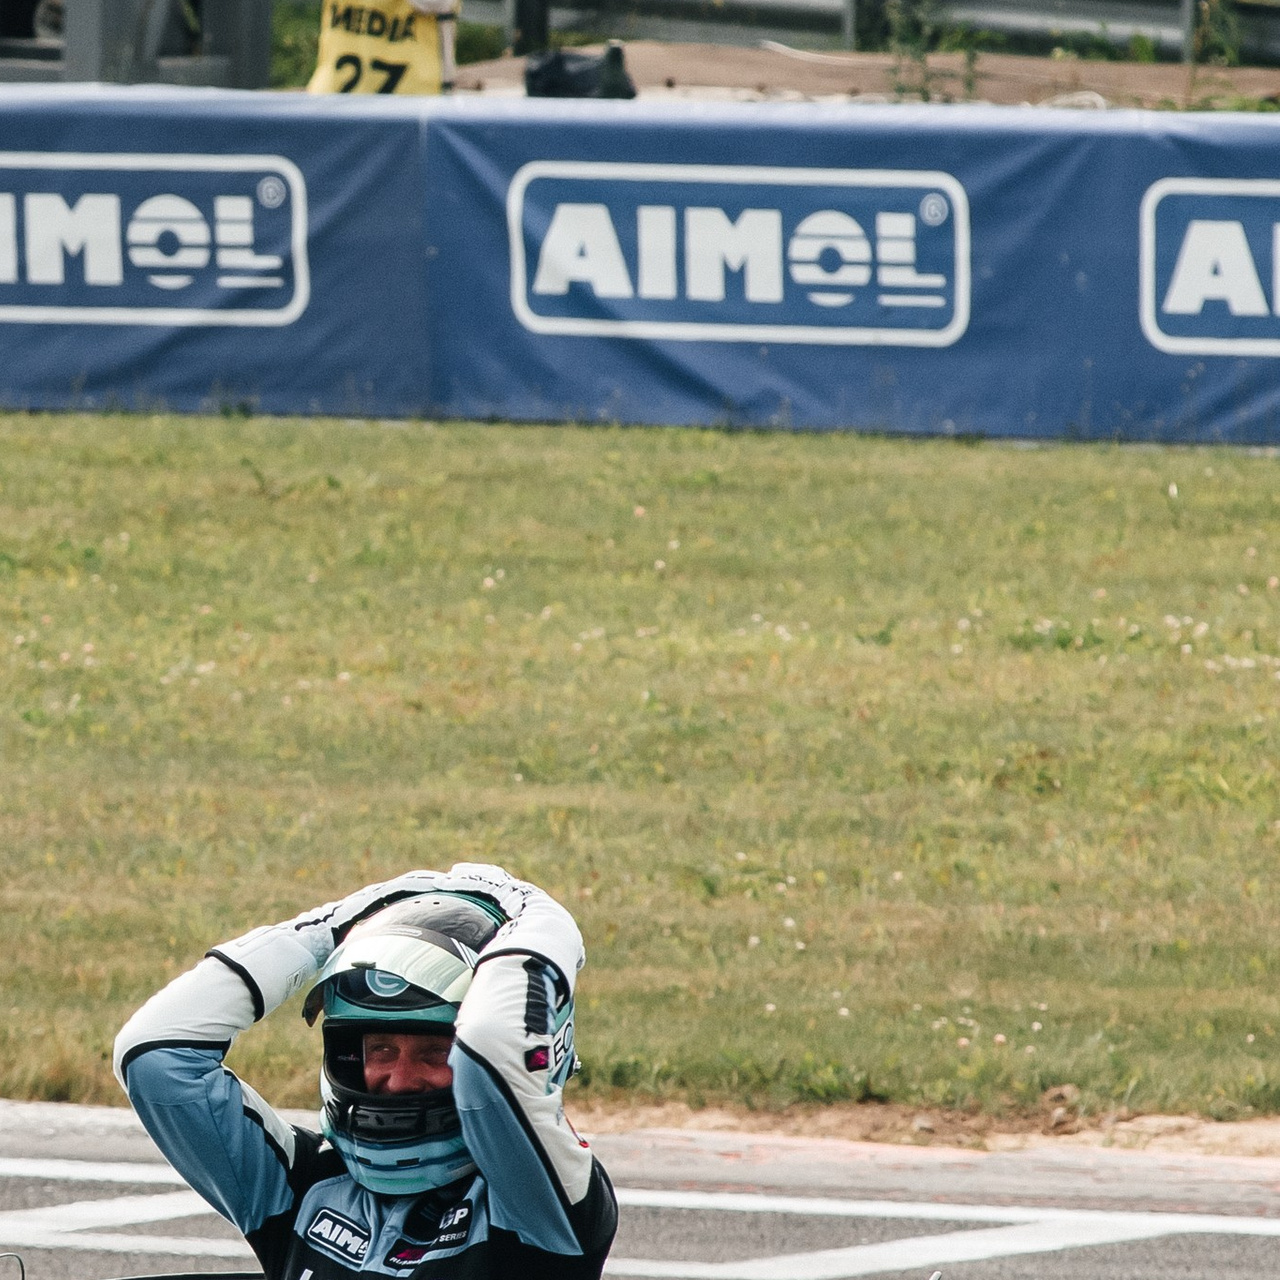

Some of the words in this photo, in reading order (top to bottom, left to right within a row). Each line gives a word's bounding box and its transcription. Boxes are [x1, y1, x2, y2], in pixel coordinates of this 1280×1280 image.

[329, 3, 417, 42] MEDIA
[335, 54, 409, 94] 27
[532, 203, 946, 308] AIMOL
[312, 1217, 370, 1258] AIM
